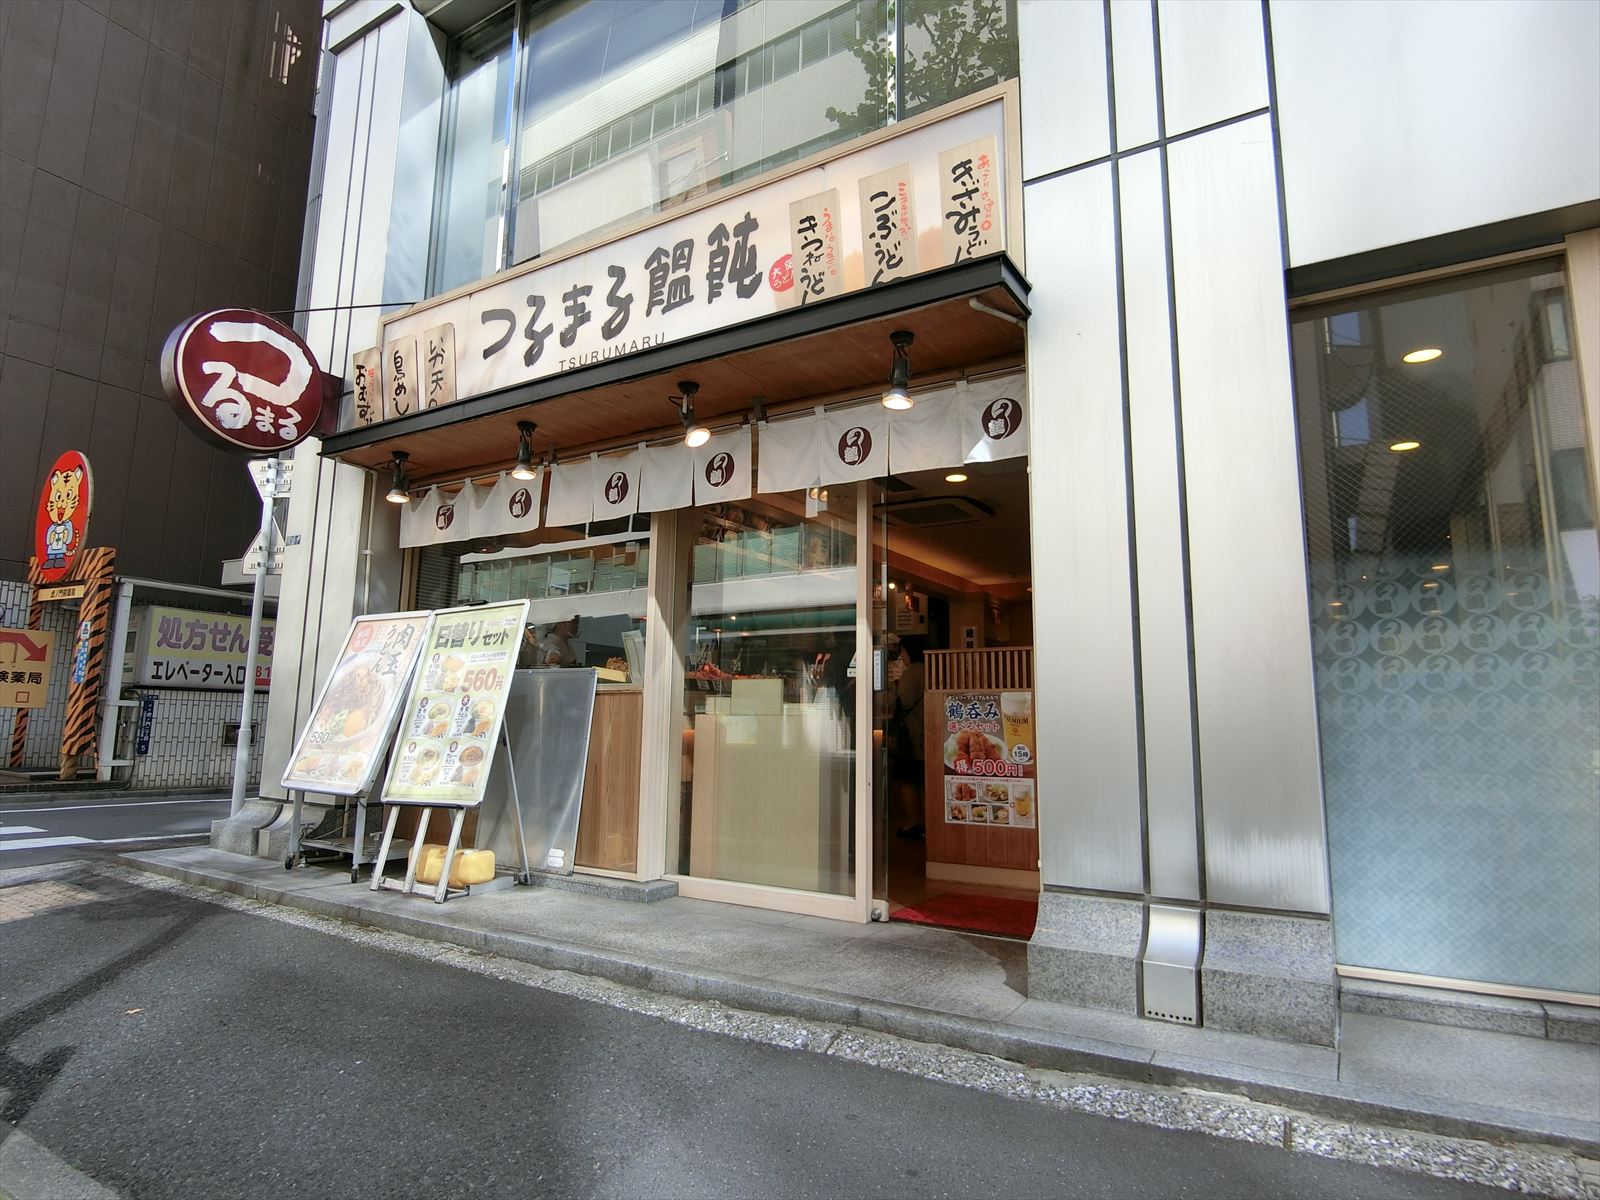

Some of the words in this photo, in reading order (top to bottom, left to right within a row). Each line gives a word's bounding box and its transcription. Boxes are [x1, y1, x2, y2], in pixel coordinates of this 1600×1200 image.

[559, 332, 665, 371] TSURUMARU
[151, 660, 247, 685] エレベーター入口
[947, 701, 1000, 720] 鶴呑み
[973, 760, 1018, 777] 500円
